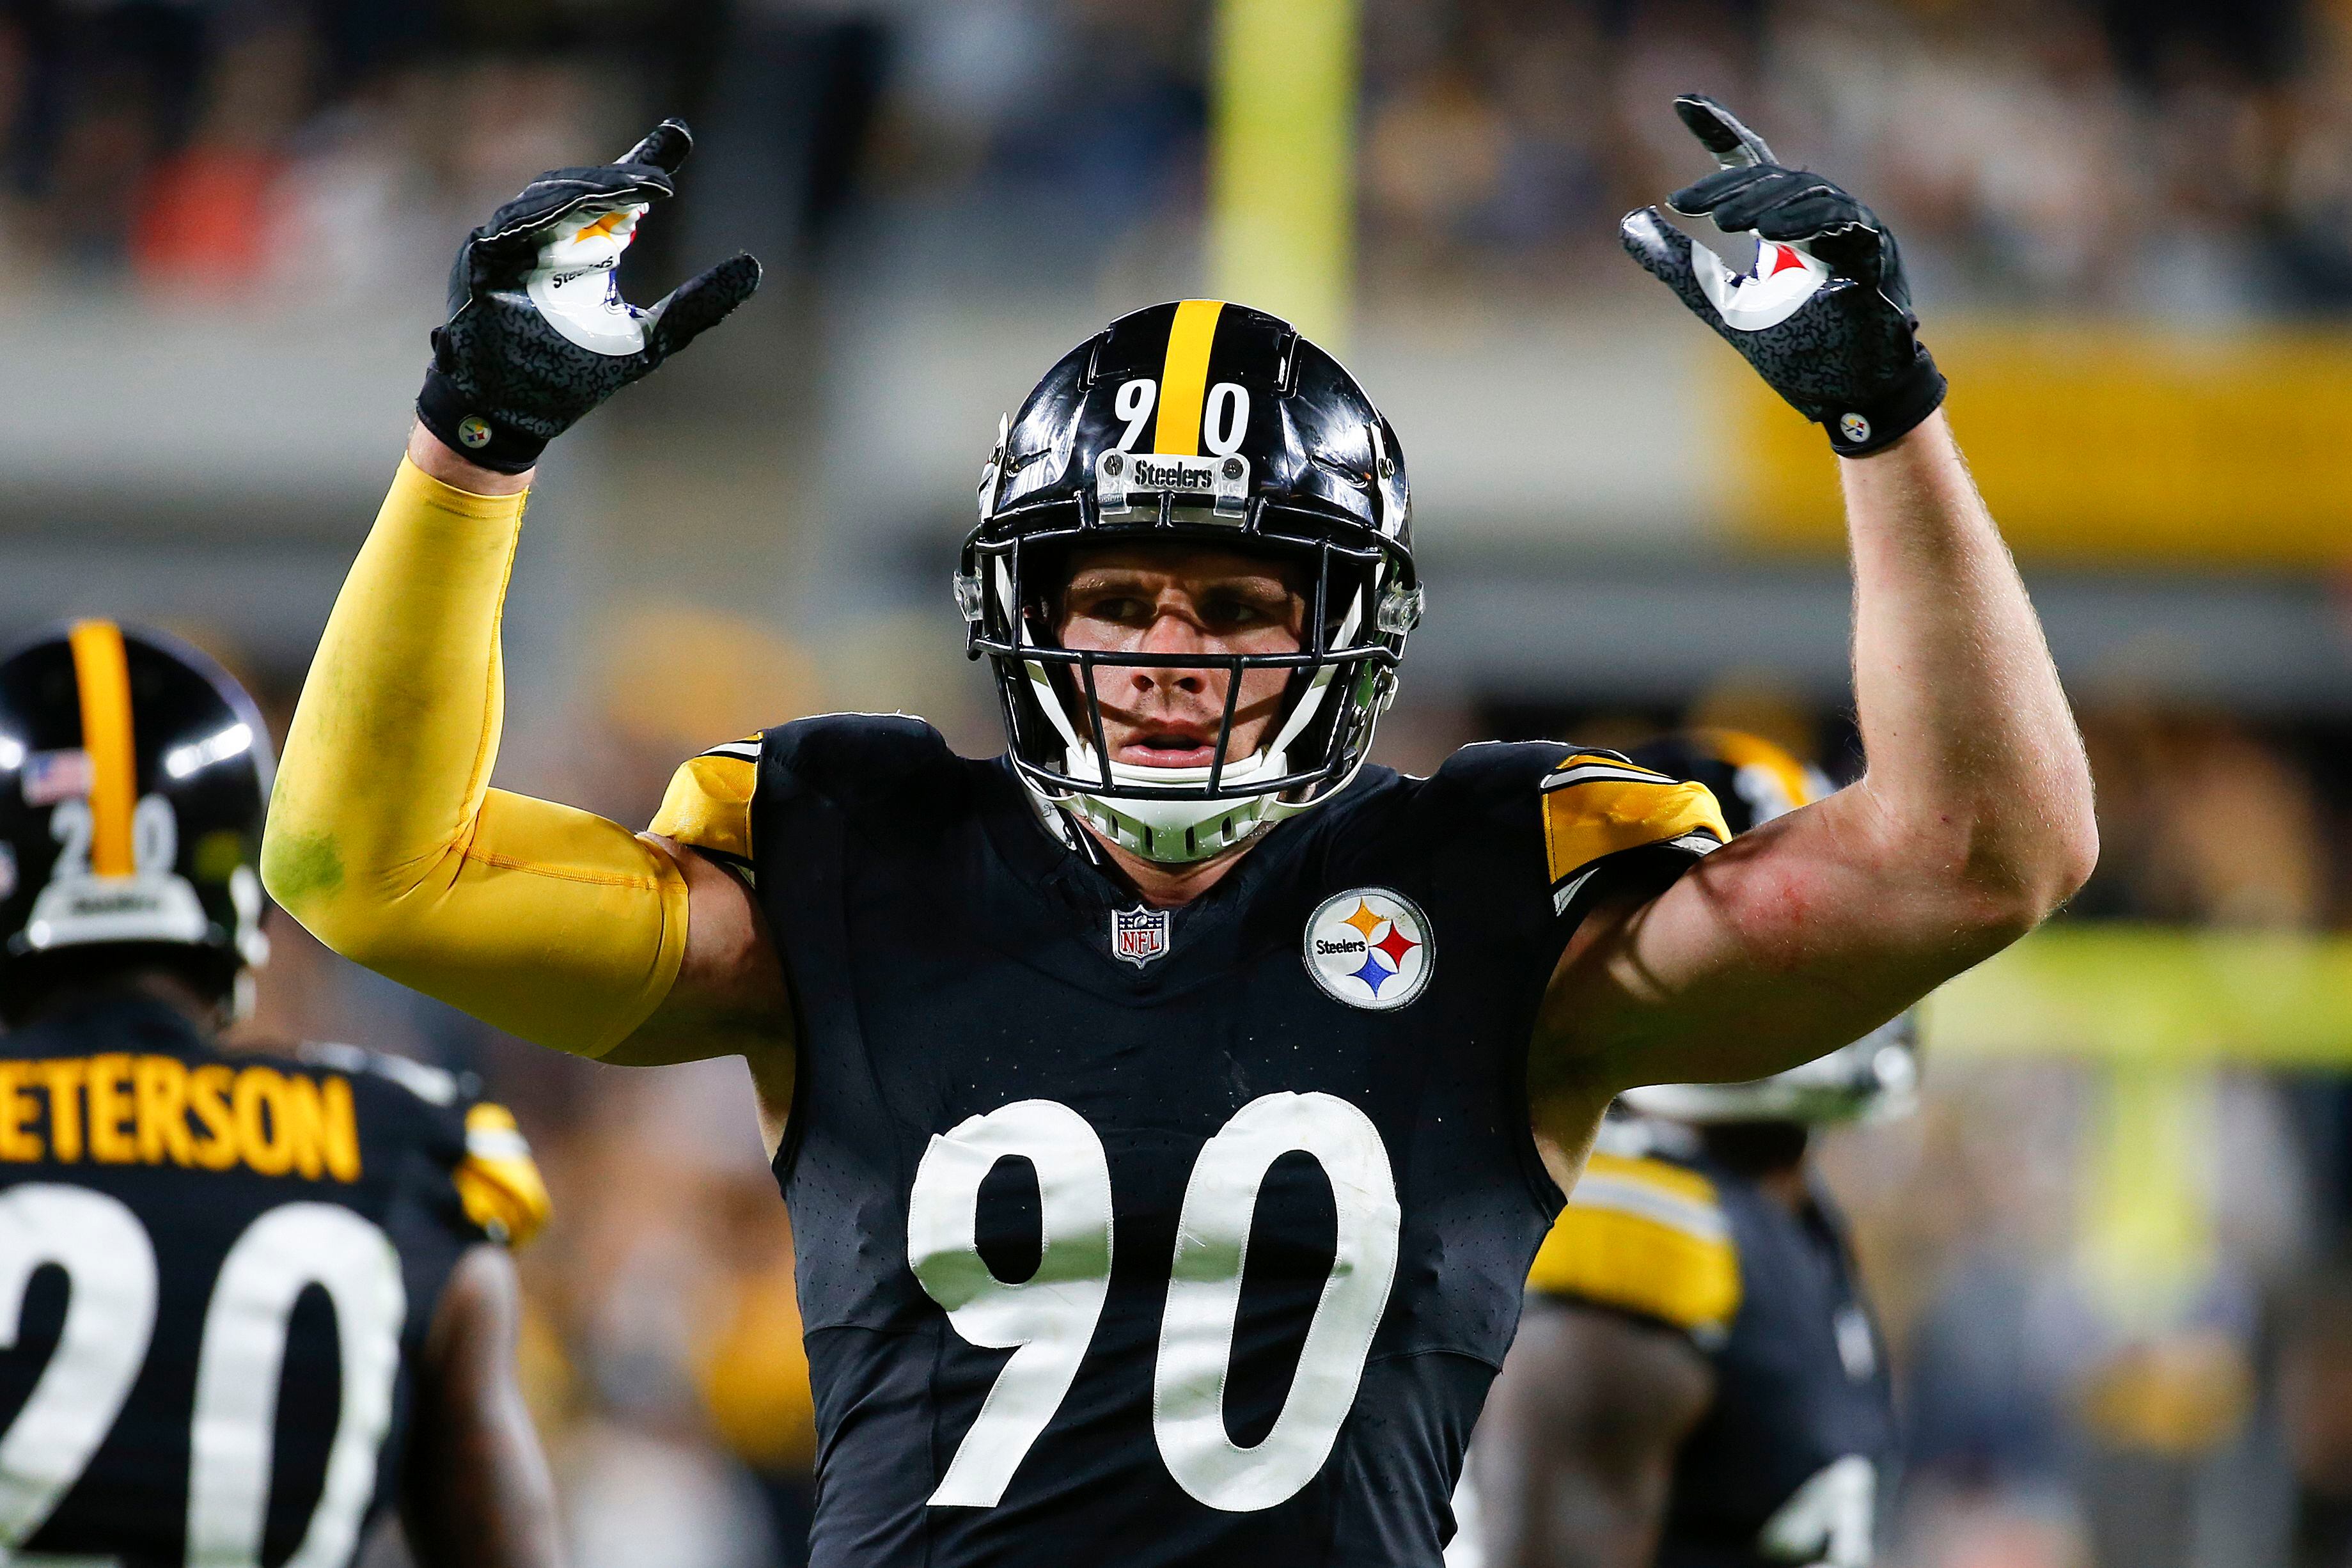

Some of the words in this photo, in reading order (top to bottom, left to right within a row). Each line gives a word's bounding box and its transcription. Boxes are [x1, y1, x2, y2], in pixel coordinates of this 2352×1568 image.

[553, 256, 613, 288] Steers
[1135, 460, 1212, 488] Steelers
[1120, 930, 1160, 955] NFL
[1316, 939, 1366, 955] Steelers
[907, 1091, 1401, 1512] 90
[0, 1183, 407, 1568] 20
